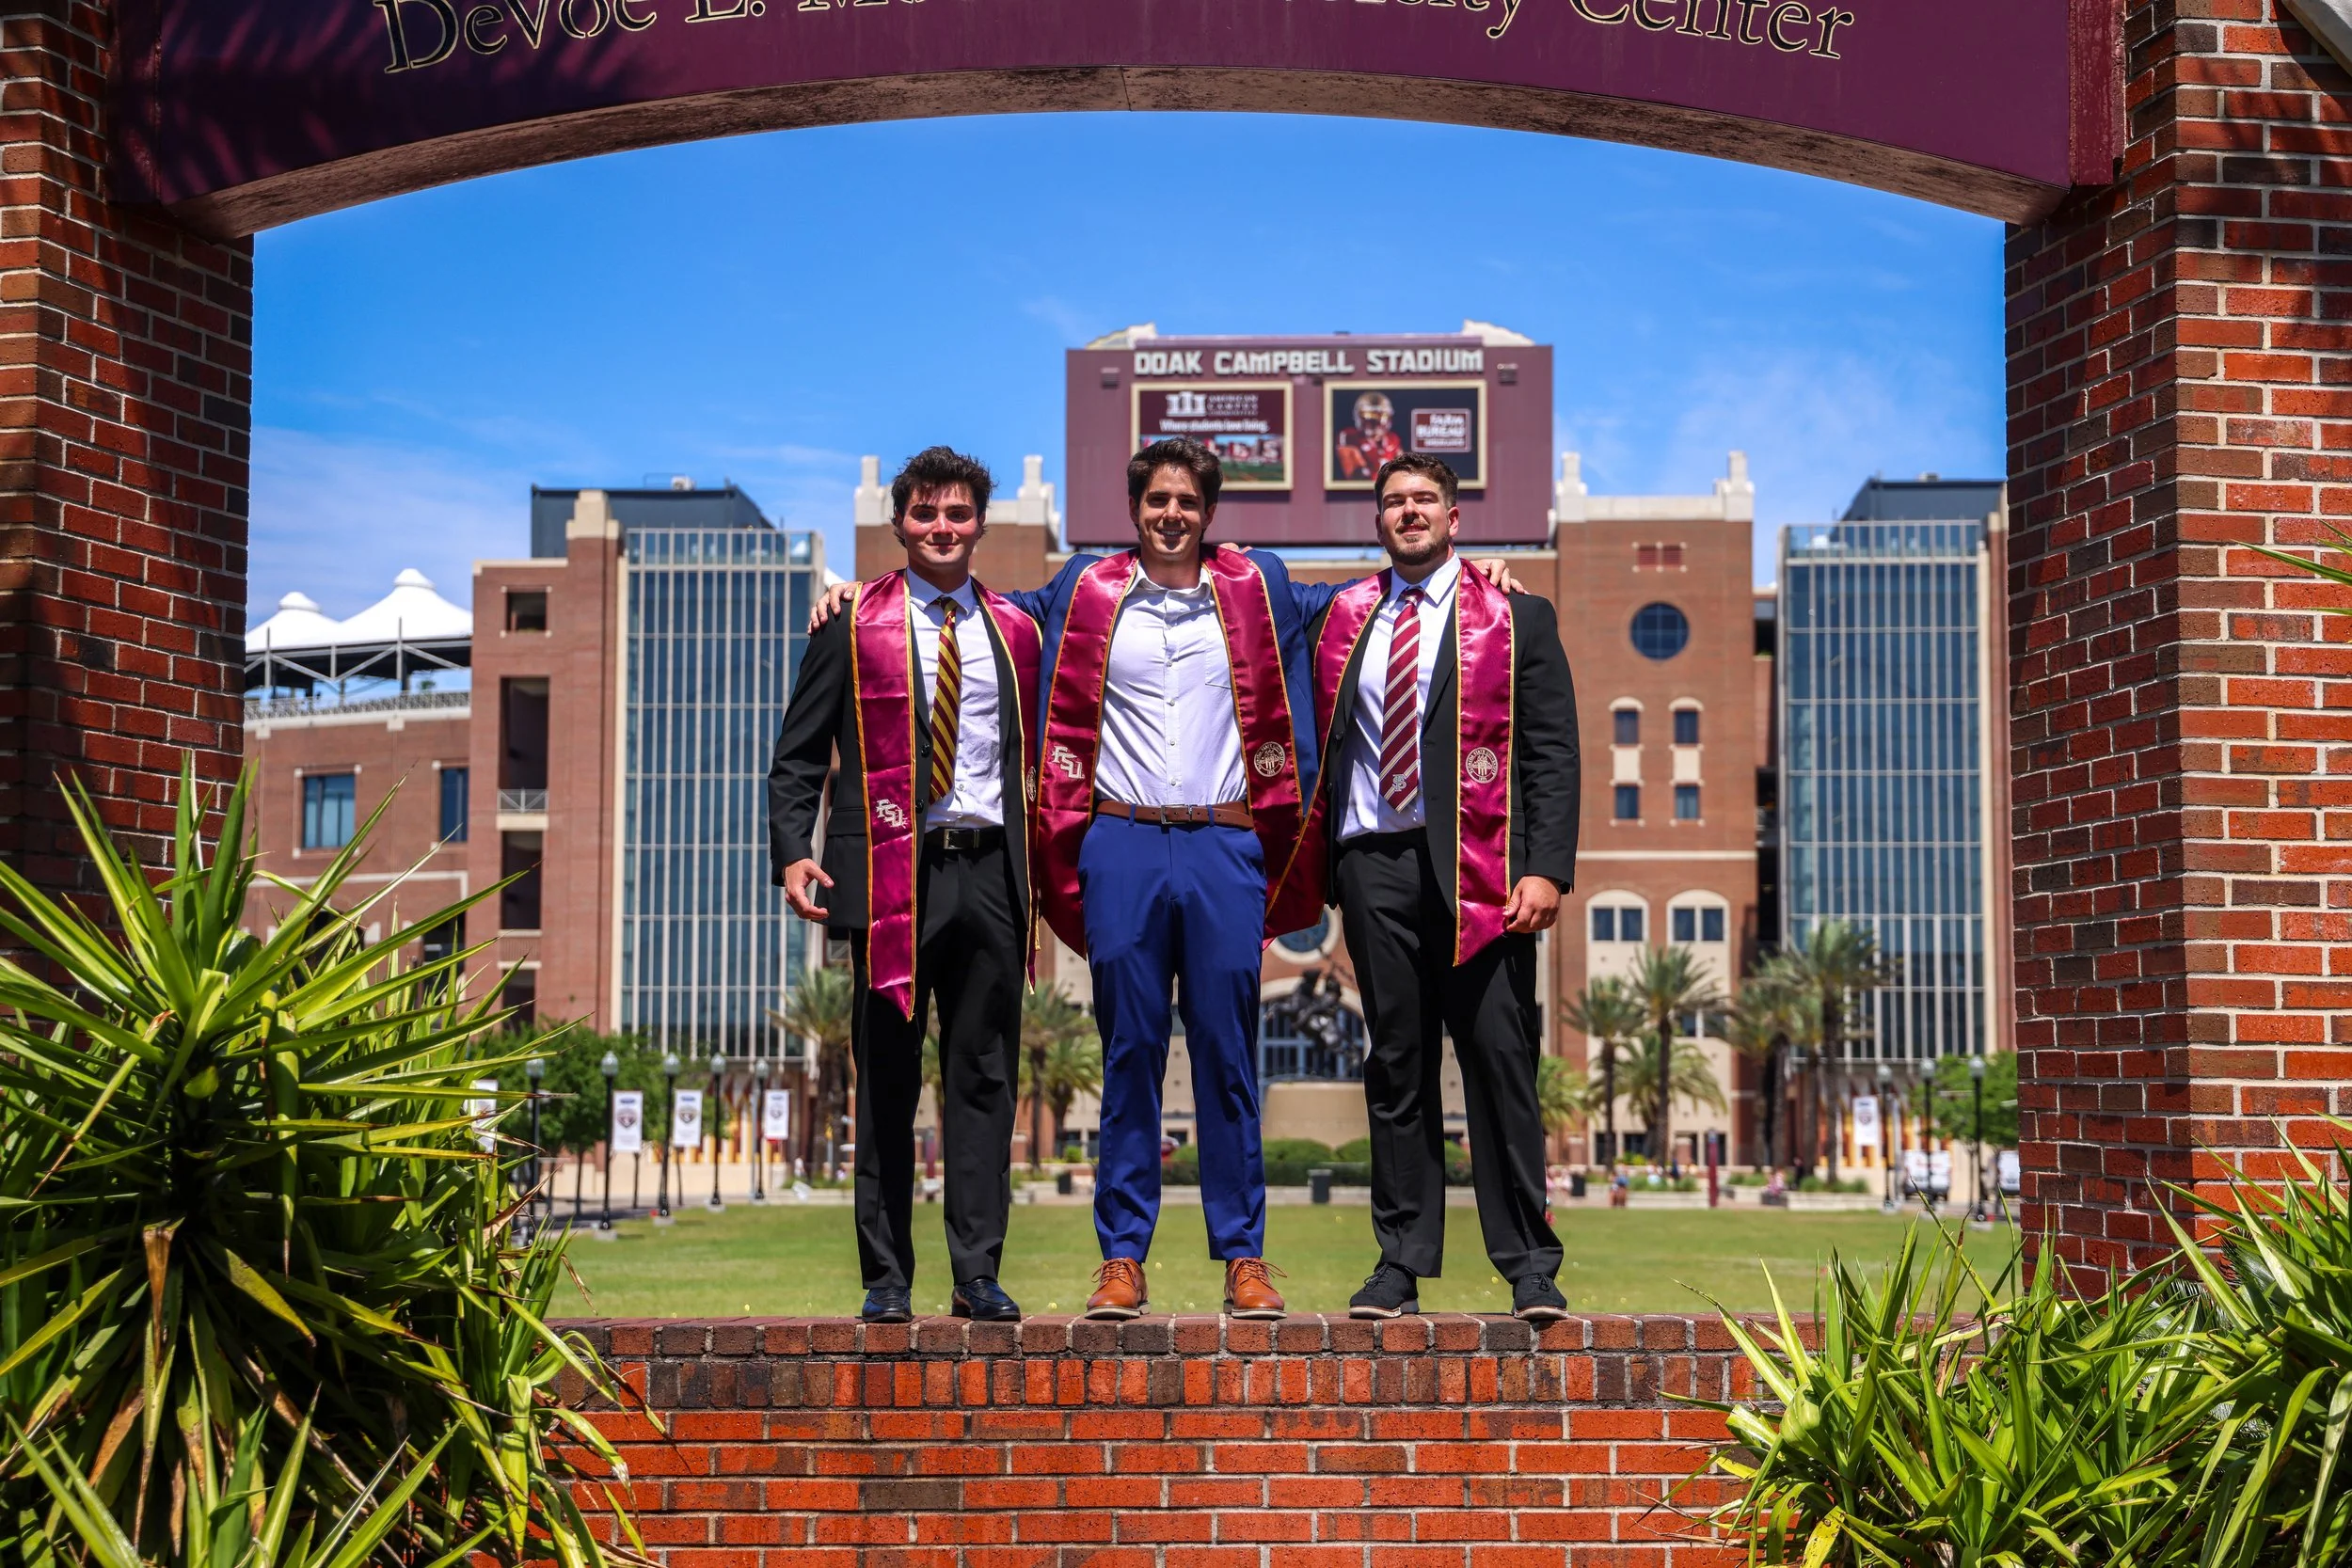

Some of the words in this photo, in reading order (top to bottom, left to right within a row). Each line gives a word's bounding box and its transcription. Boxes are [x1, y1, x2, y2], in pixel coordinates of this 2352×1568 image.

[1134, 351, 1203, 374] DOAK
[1214, 350, 1355, 374] CAMPBELL
[1366, 349, 1484, 373] STADIUM
[1052, 745, 1085, 780] FSU
[876, 799, 905, 828] FSU
